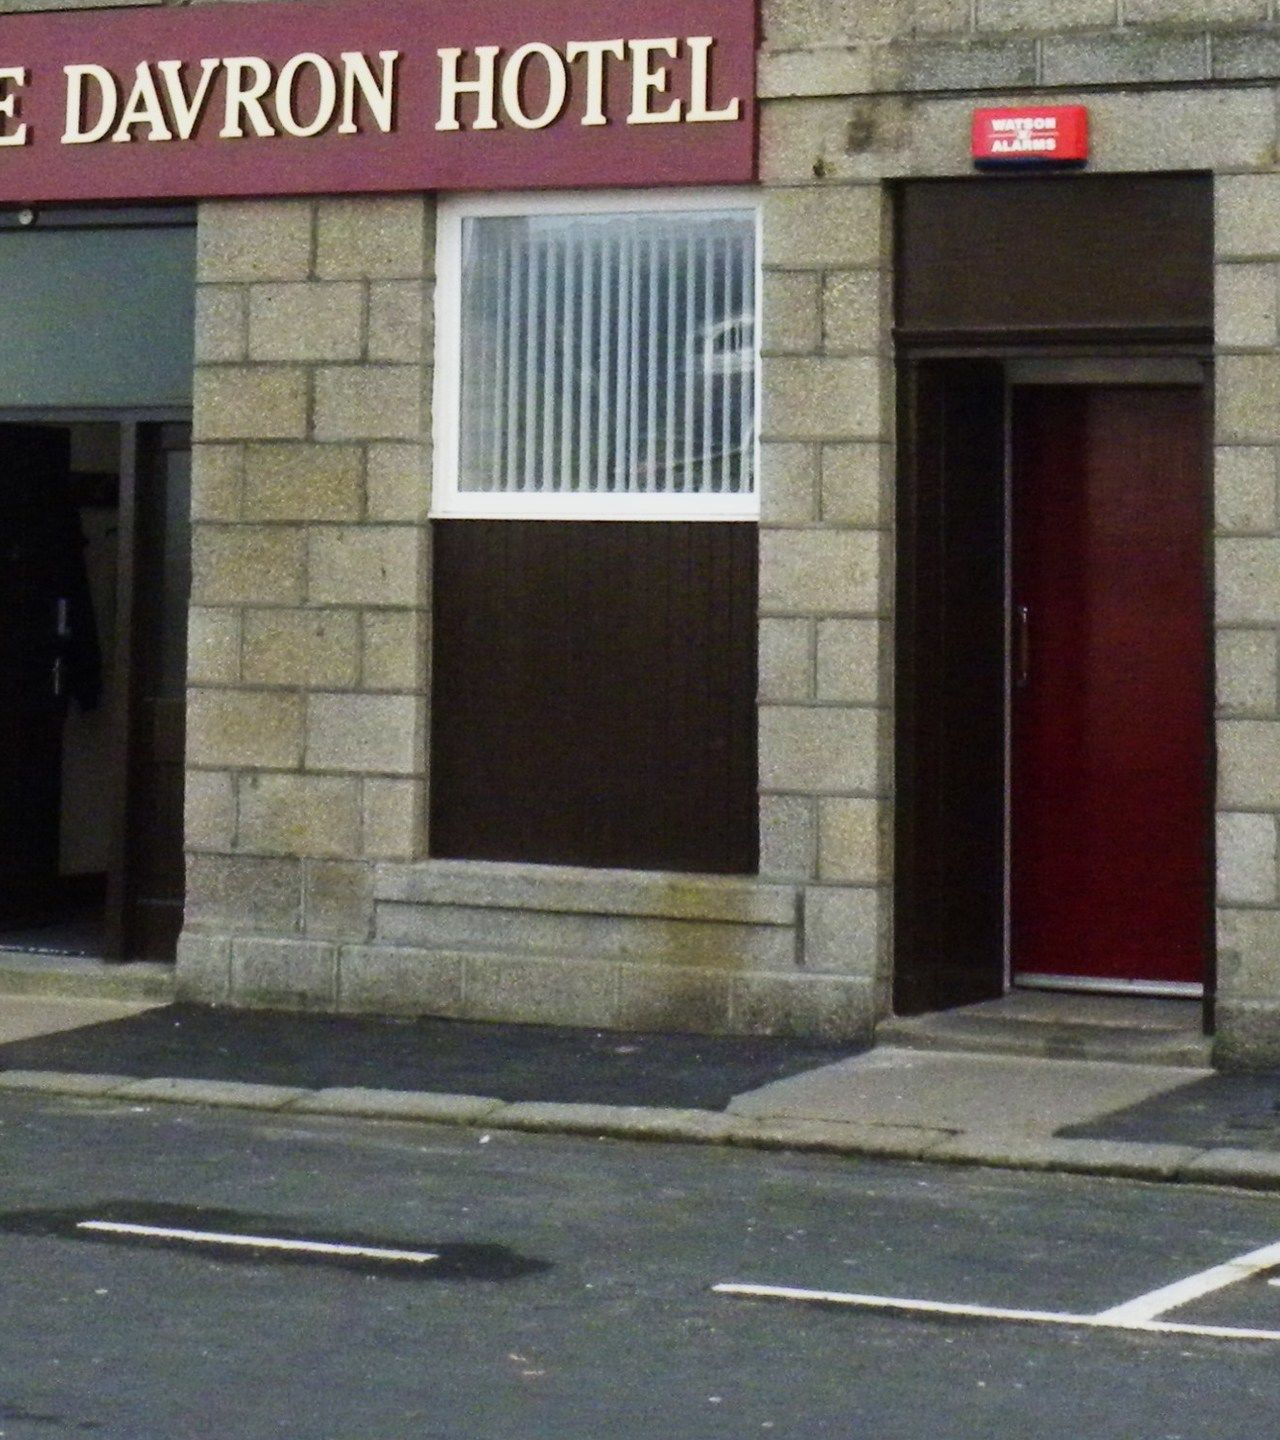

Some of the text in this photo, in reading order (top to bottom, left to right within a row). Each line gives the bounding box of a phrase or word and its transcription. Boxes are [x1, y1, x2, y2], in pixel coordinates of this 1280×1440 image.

[61, 50, 399, 144] DAVRON
[434, 36, 739, 131] HOTEL
[991, 117, 1057, 131] WATSON
[991, 138, 1057, 153] ALARMS
